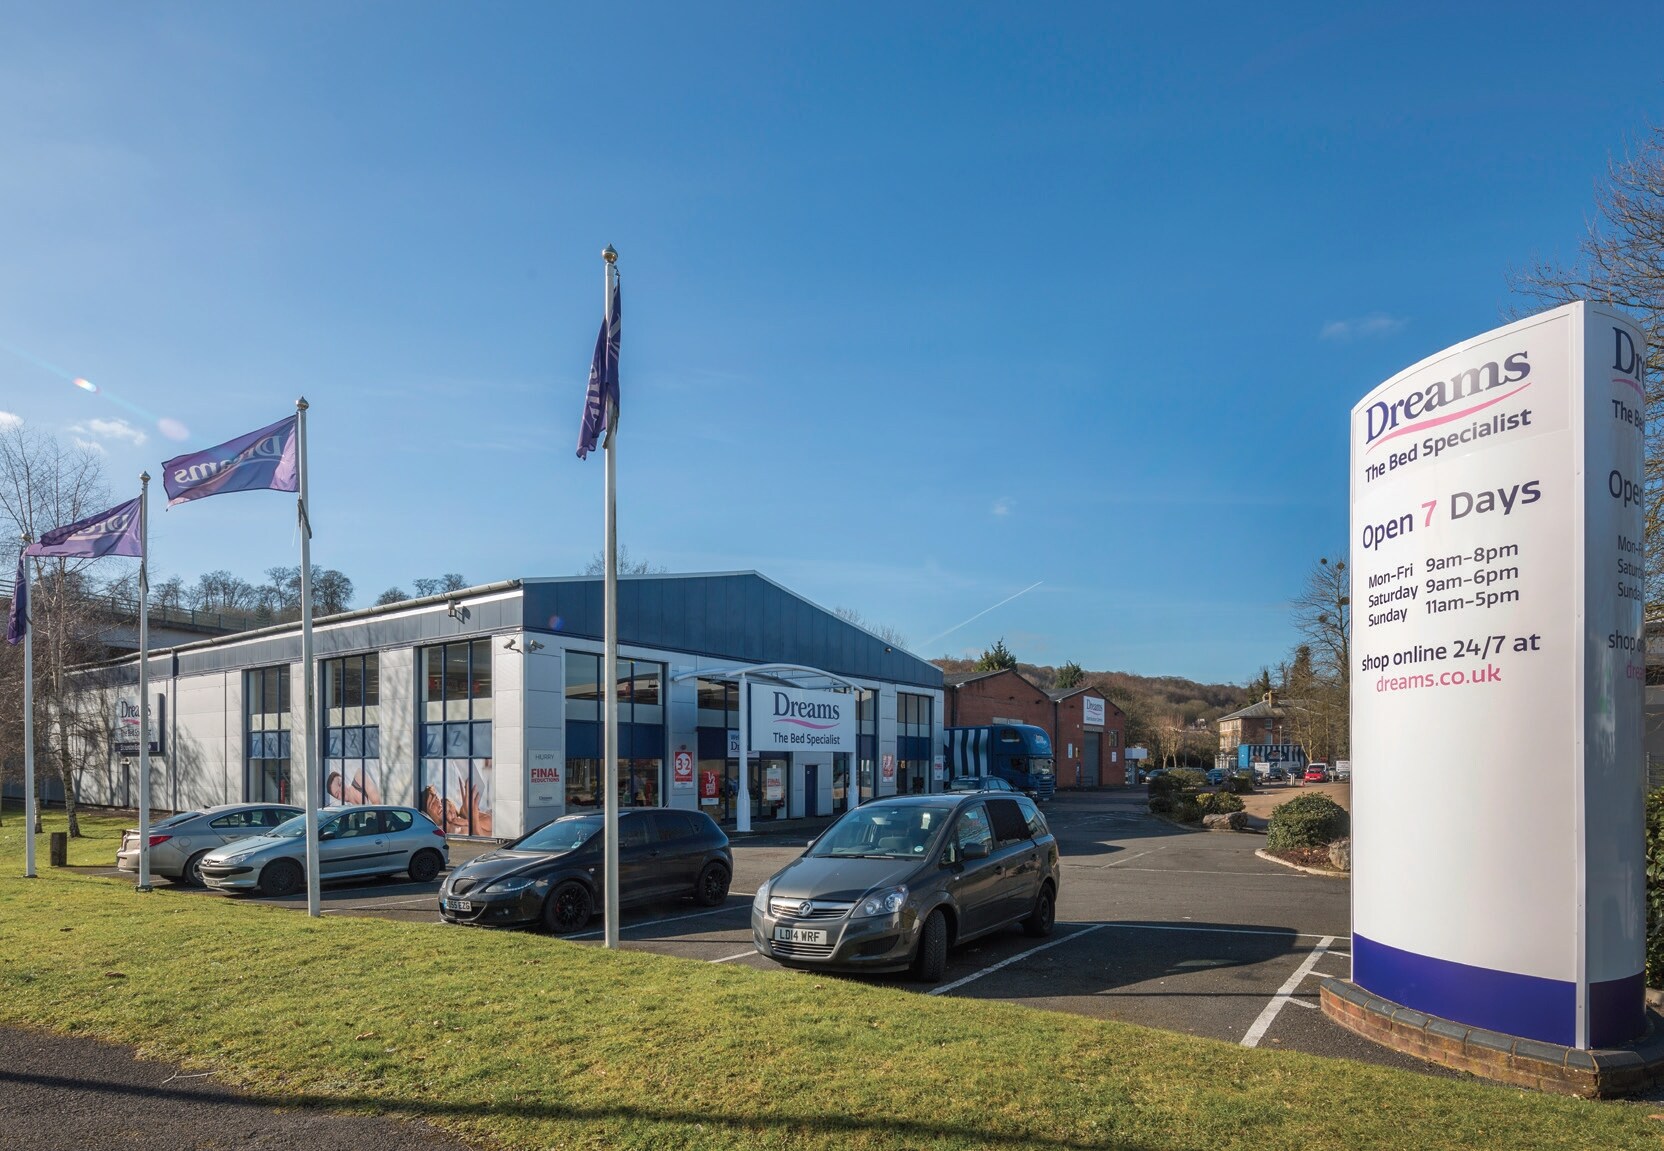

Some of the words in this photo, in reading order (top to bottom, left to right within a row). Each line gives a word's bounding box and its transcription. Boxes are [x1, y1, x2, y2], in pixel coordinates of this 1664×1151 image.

[1365, 350, 1531, 445] Dreams
[1612, 399, 1632, 424] The
[1365, 464, 1385, 483] The
[1390, 447, 1418, 471] Bed
[1423, 409, 1532, 457] Specialist
[1363, 512, 1414, 550] Open
[1422, 500, 1437, 527] 7
[1451, 479, 1541, 520] Days
[1368, 563, 1414, 589] Mon-Fri
[1426, 543, 1519, 573] 9am-8pm
[1368, 584, 1418, 608] Saturday
[1426, 566, 1519, 594] 9am-6pm
[1368, 607, 1407, 627] Sunday
[1426, 588, 1519, 615] 11am-5pm
[1362, 652, 1390, 672] shop
[1393, 645, 1448, 667] online
[1453, 636, 1506, 664] 24/7
[1513, 633, 1540, 652] at
[1608, 630, 1635, 656] shop
[1376, 664, 1502, 693] dreams.co.uk
[121, 701, 151, 718] Dreas
[773, 692, 840, 720] Dreams
[773, 732, 788, 743] The
[791, 733, 804, 743] Bed
[807, 734, 840, 746] Specialist
[531, 768, 560, 778] FINAL
[780, 929, 798, 941] LD14
[801, 931, 820, 942] WRF
